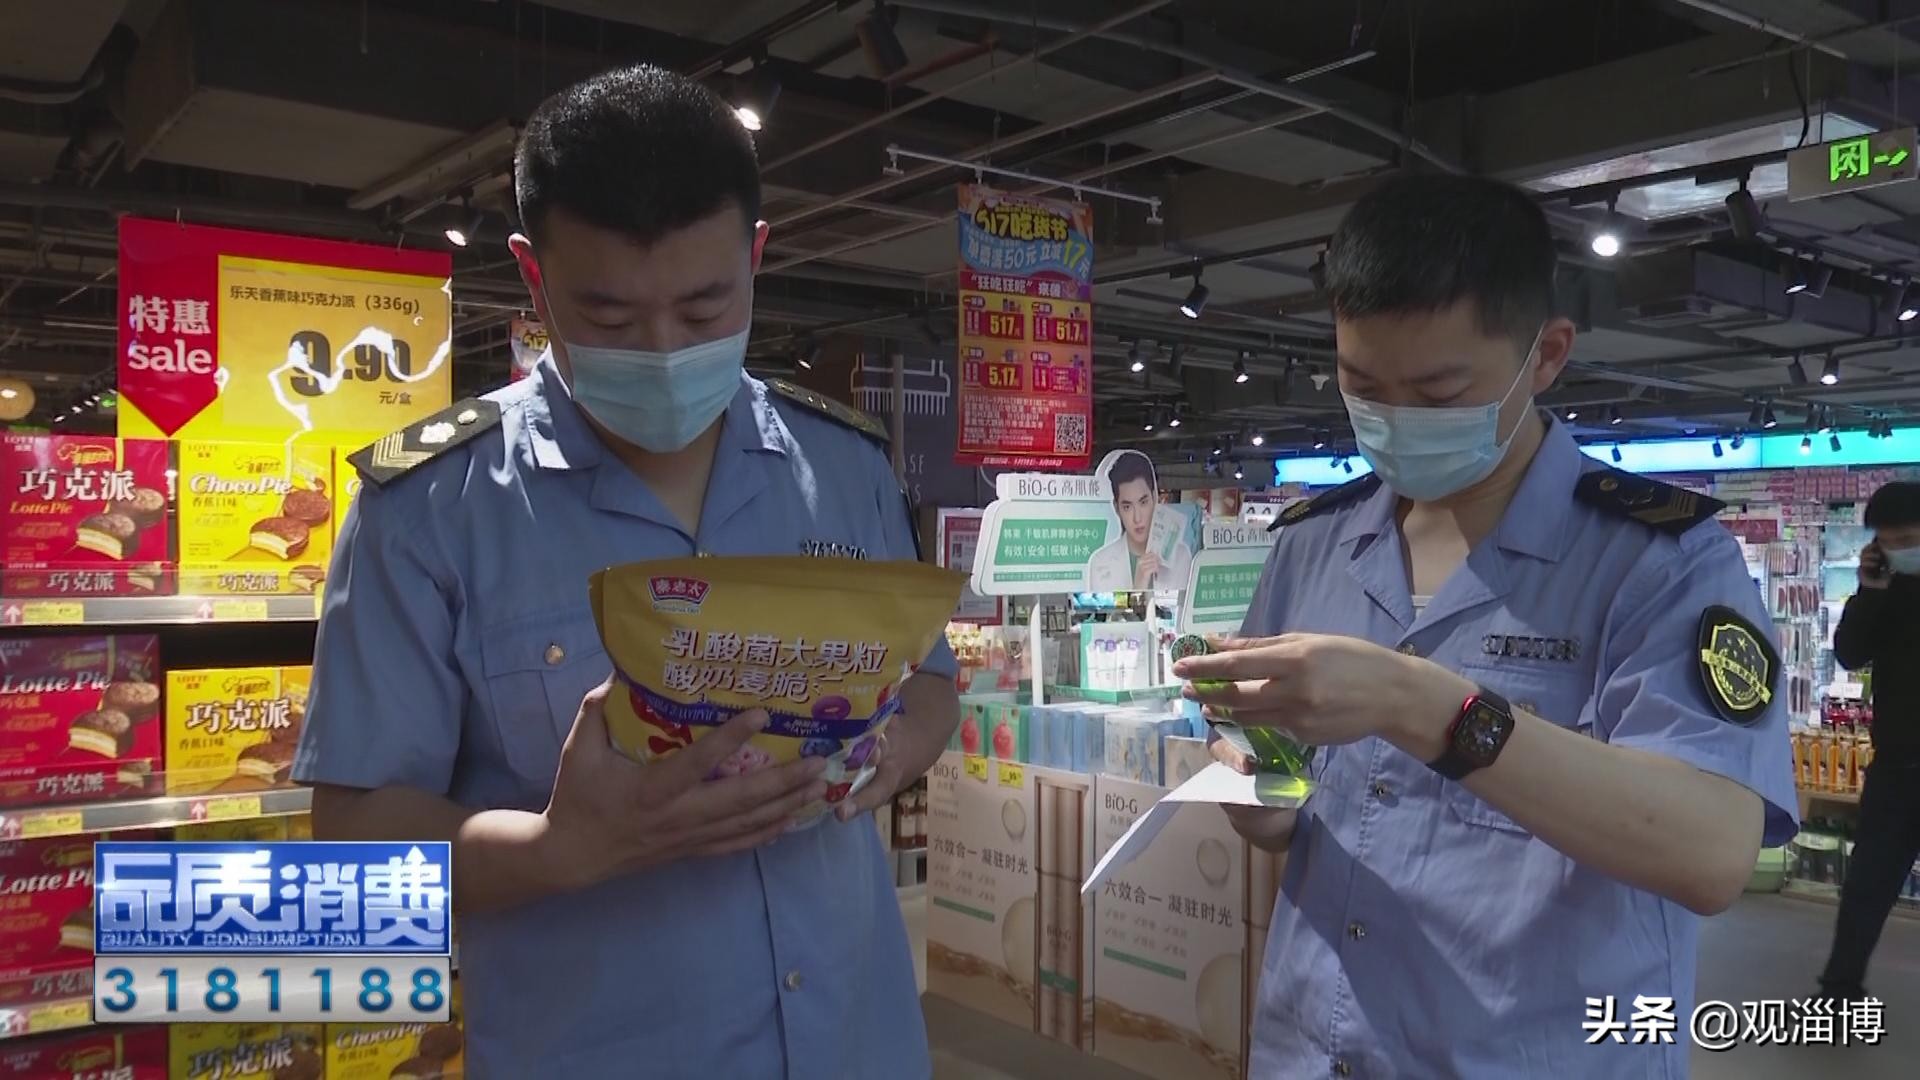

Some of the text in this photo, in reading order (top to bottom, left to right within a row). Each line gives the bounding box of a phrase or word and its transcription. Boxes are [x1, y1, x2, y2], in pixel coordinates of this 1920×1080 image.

[128, 295, 211, 336] 特惠
[128, 339, 213, 375] sale
[289, 330, 411, 397] 9.90
[988, 365, 1016, 387] 5.17
[379, 391, 411, 405] 元/盒
[19, 467, 136, 502] 巧克派
[10, 501, 74, 514] Lotte Pie
[47, 571, 115, 592] 巧克派
[218, 573, 280, 592] 巧克派
[660, 628, 889, 675] 乳酸菌大果粒
[1, 674, 70, 695] Lotte
[663, 662, 811, 703] 酸奶麦脆
[186, 698, 292, 734] 巧克派
[36, 772, 104, 796] 巧克派
[933, 834, 1029, 875] 六效合一 凝驻时光
[66, 867, 94, 888] Pi
[1104, 878, 1233, 928] 六效合一 凝驻时光
[188, 1036, 294, 1080] 巧克派
